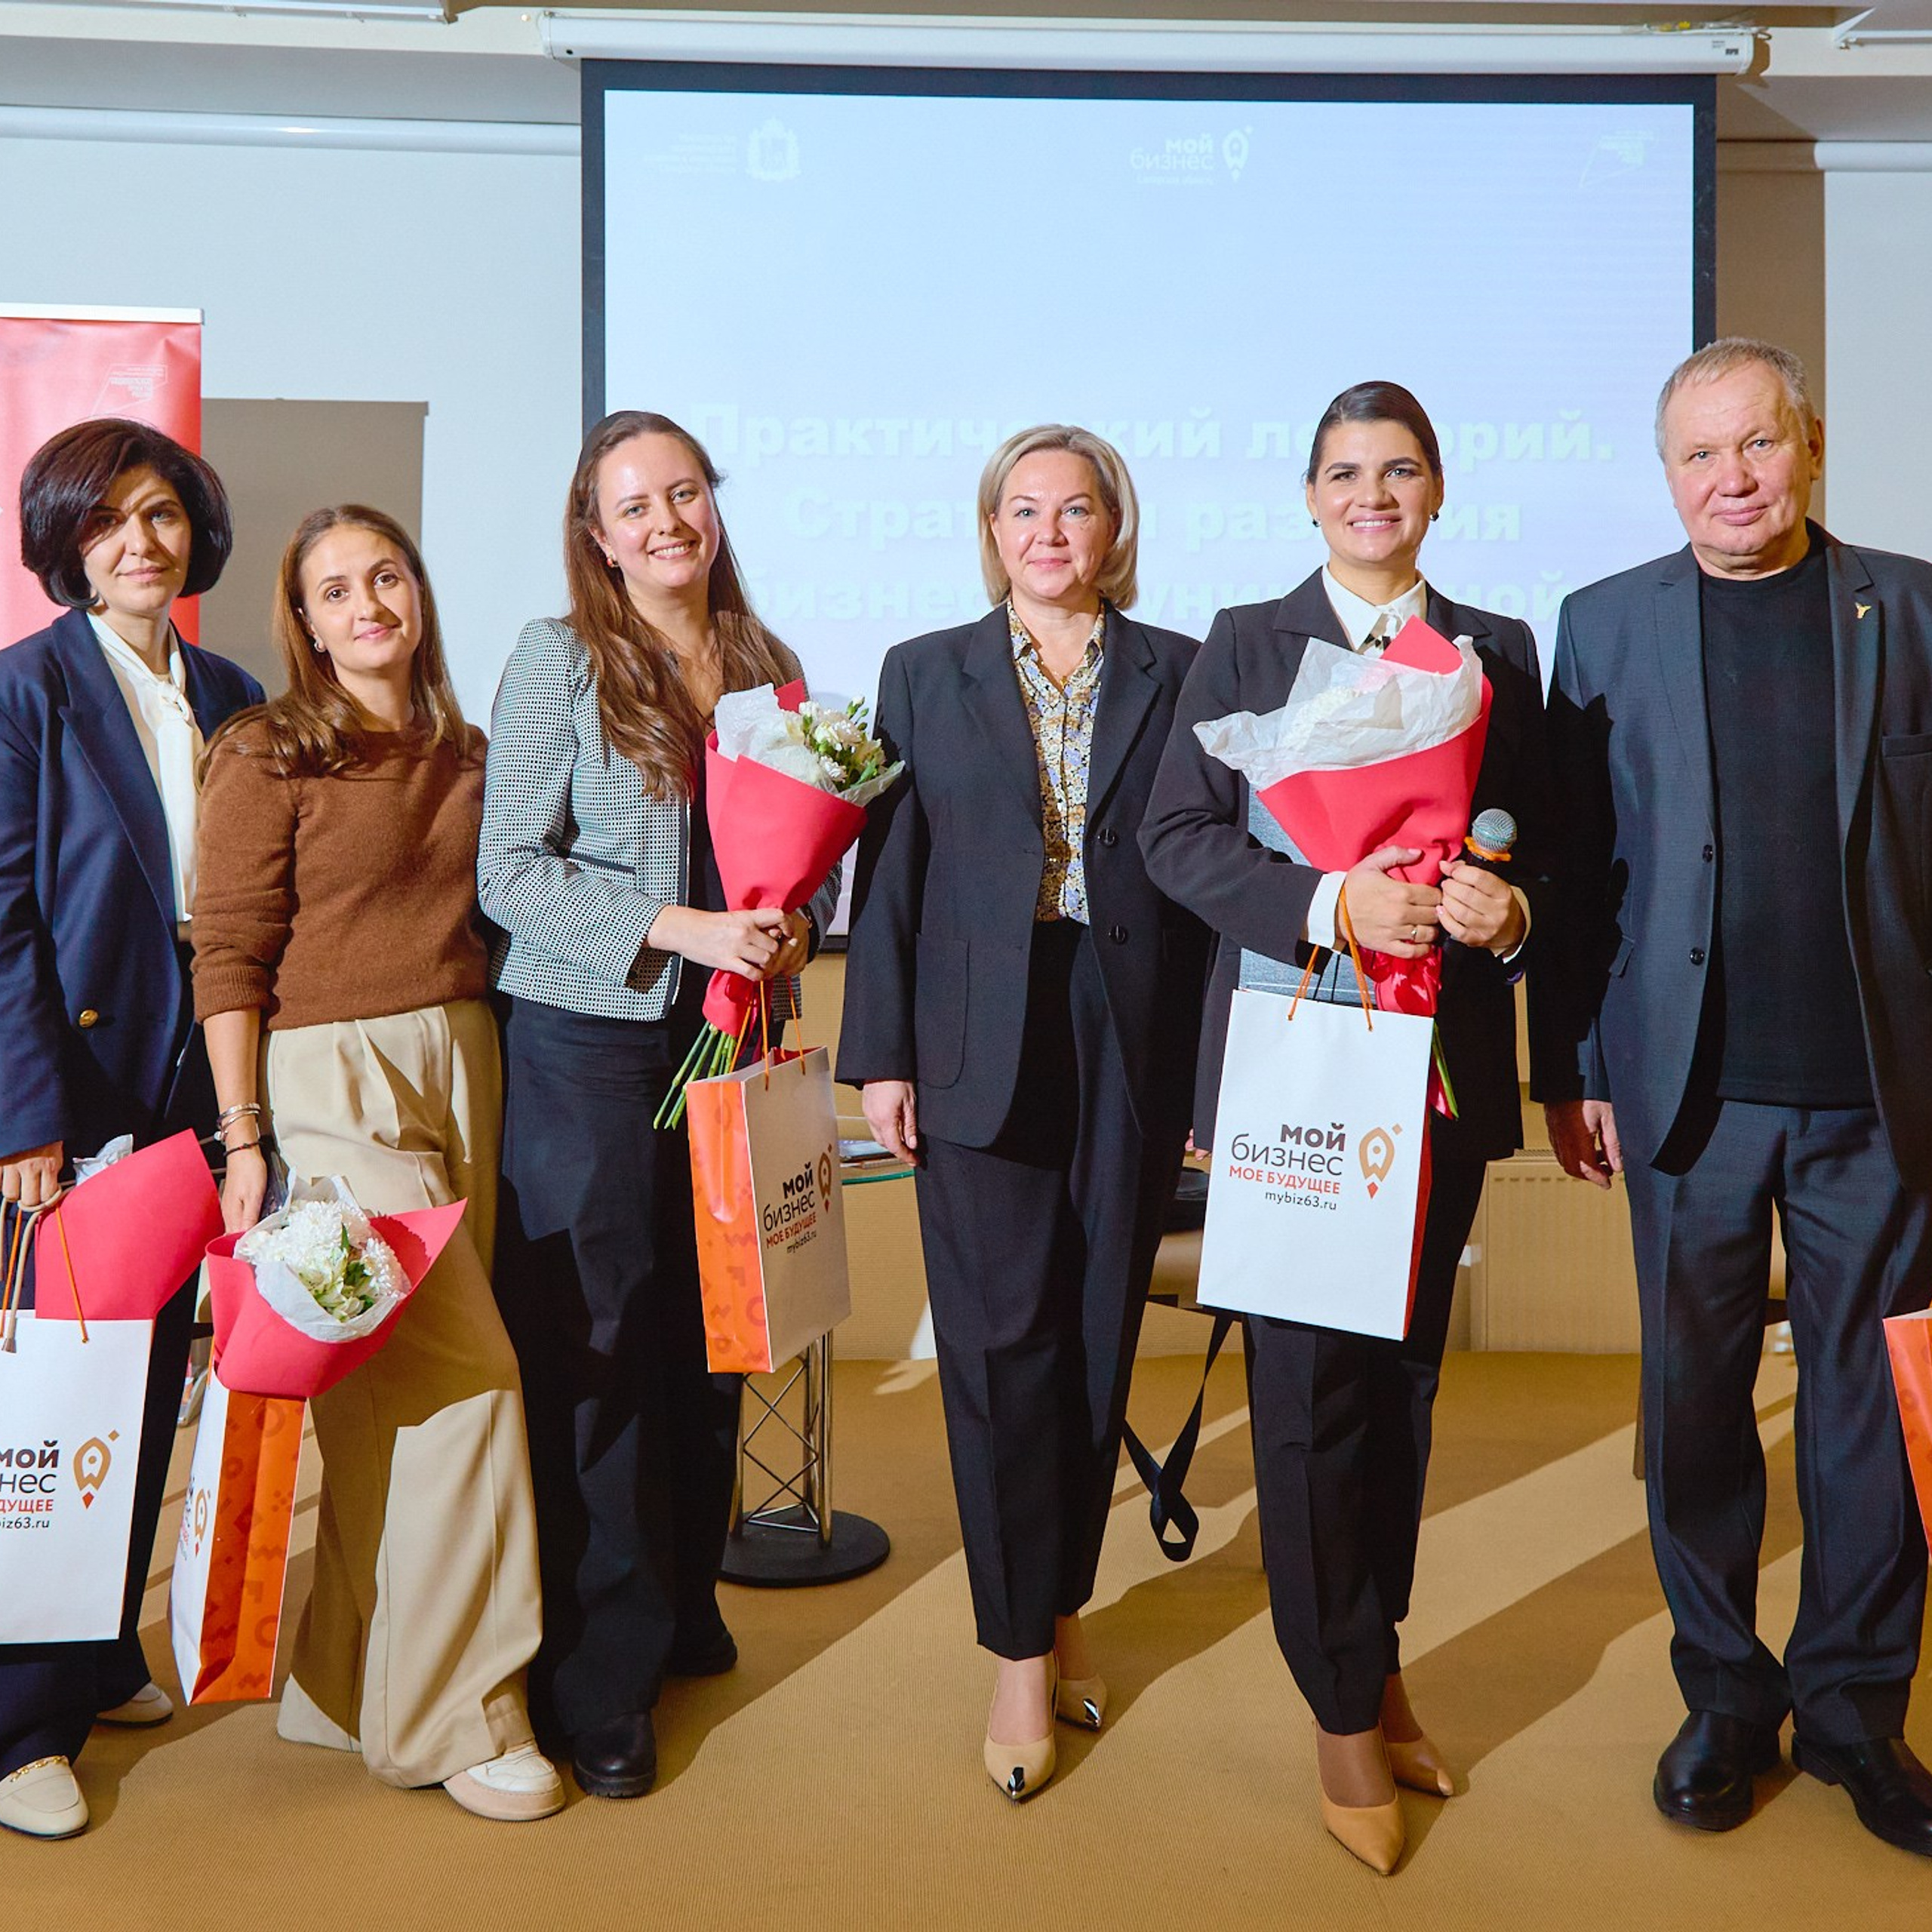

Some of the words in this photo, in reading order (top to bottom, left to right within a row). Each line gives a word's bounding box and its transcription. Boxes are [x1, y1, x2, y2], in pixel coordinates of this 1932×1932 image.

[1164, 133, 1214, 153] мой
[1130, 147, 1214, 170] бизнес
[690, 403, 1221, 469] Практичкий
[1246, 408, 1615, 473] лерий.
[1186, 501, 1521, 552] разия
[1280, 1122, 1346, 1152] мой
[1231, 1133, 1343, 1176] бизнес
[783, 1161, 814, 1199] мой
[1229, 1165, 1263, 1183] МОЕ
[1267, 1171, 1341, 1194] БУДУЩЕЕ
[763, 1190, 816, 1232] бизнес
[1265, 1191, 1337, 1211] mybiz63.ru
[766, 1230, 784, 1249] МОЕ
[785, 1212, 817, 1239] БУДУЩЕЕ
[0, 1440, 60, 1469] мой
[0, 1474, 57, 1494] нес
[0, 1500, 54, 1514] ДУЩЕЕ
[0, 1517, 50, 1529] iz63.ru
